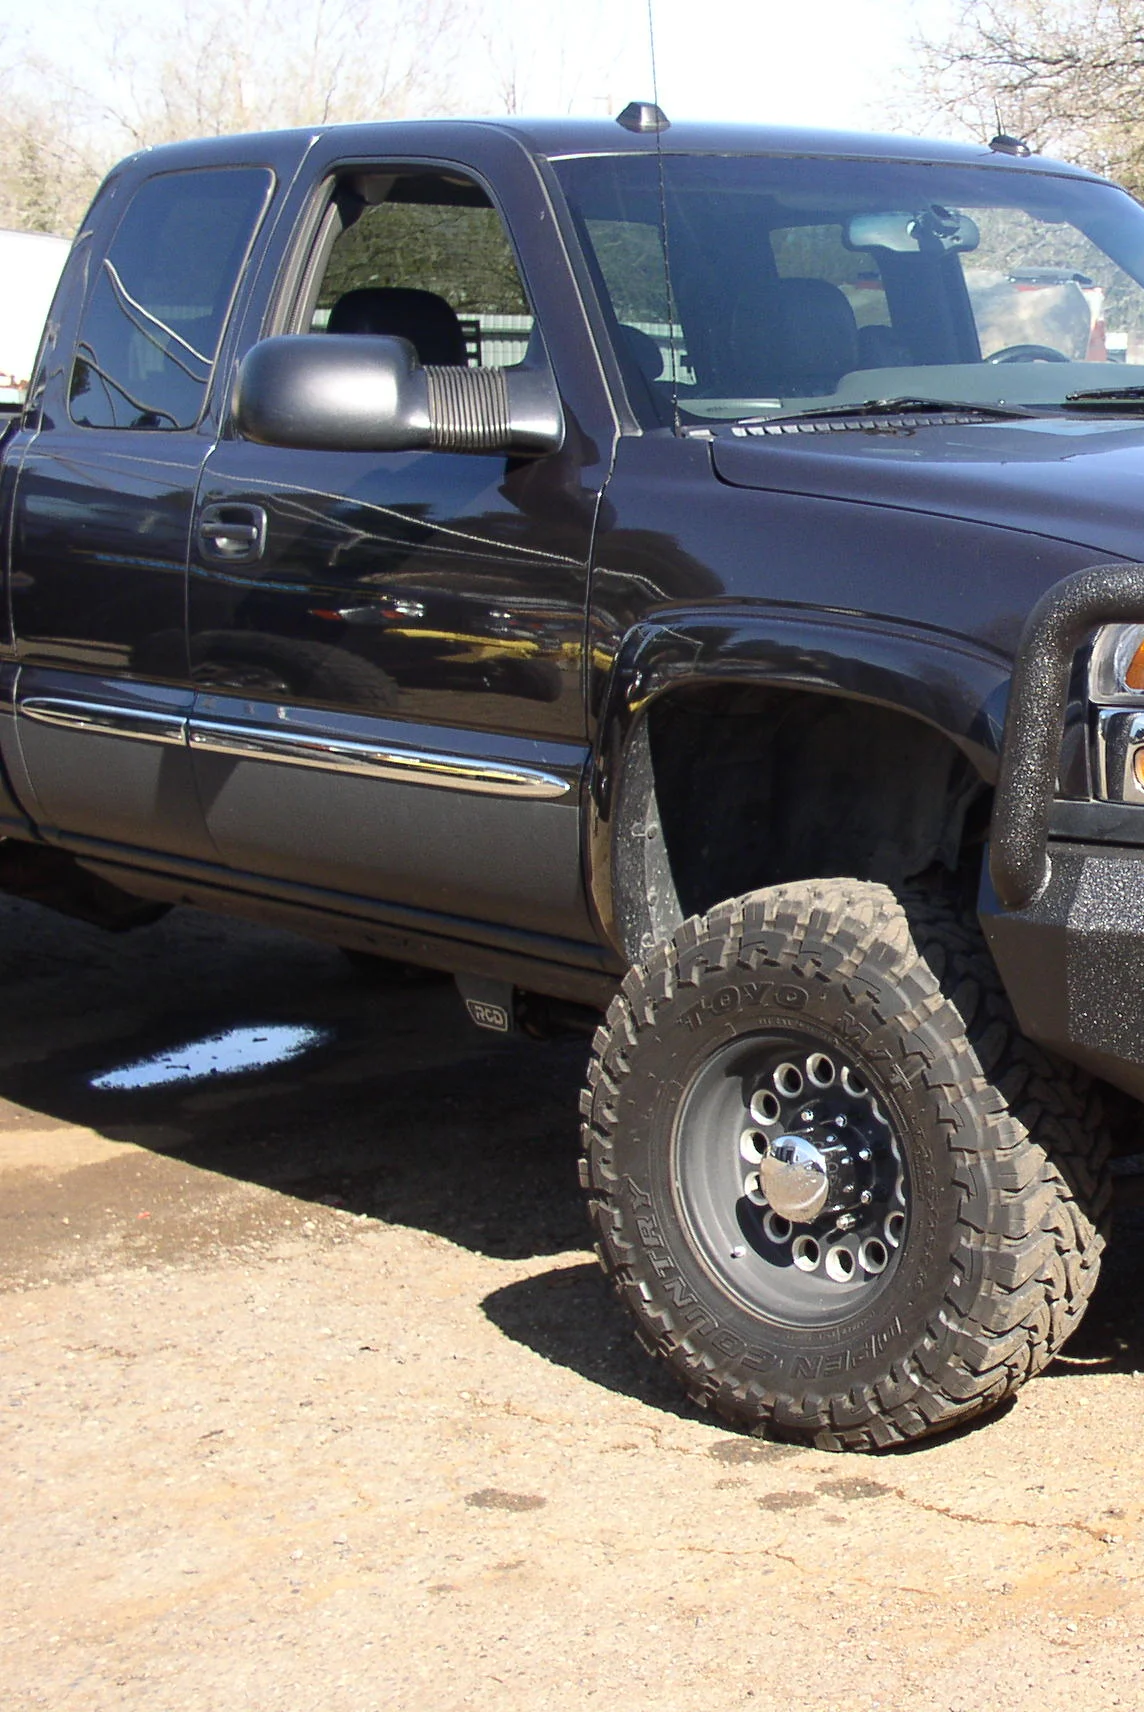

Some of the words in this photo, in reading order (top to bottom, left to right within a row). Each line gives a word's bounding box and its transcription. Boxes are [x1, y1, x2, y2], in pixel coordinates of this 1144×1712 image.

[677, 981, 810, 1033] TOYO
[621, 1173, 778, 1374] COUNTRY
[790, 1315, 902, 1379] OPEN
